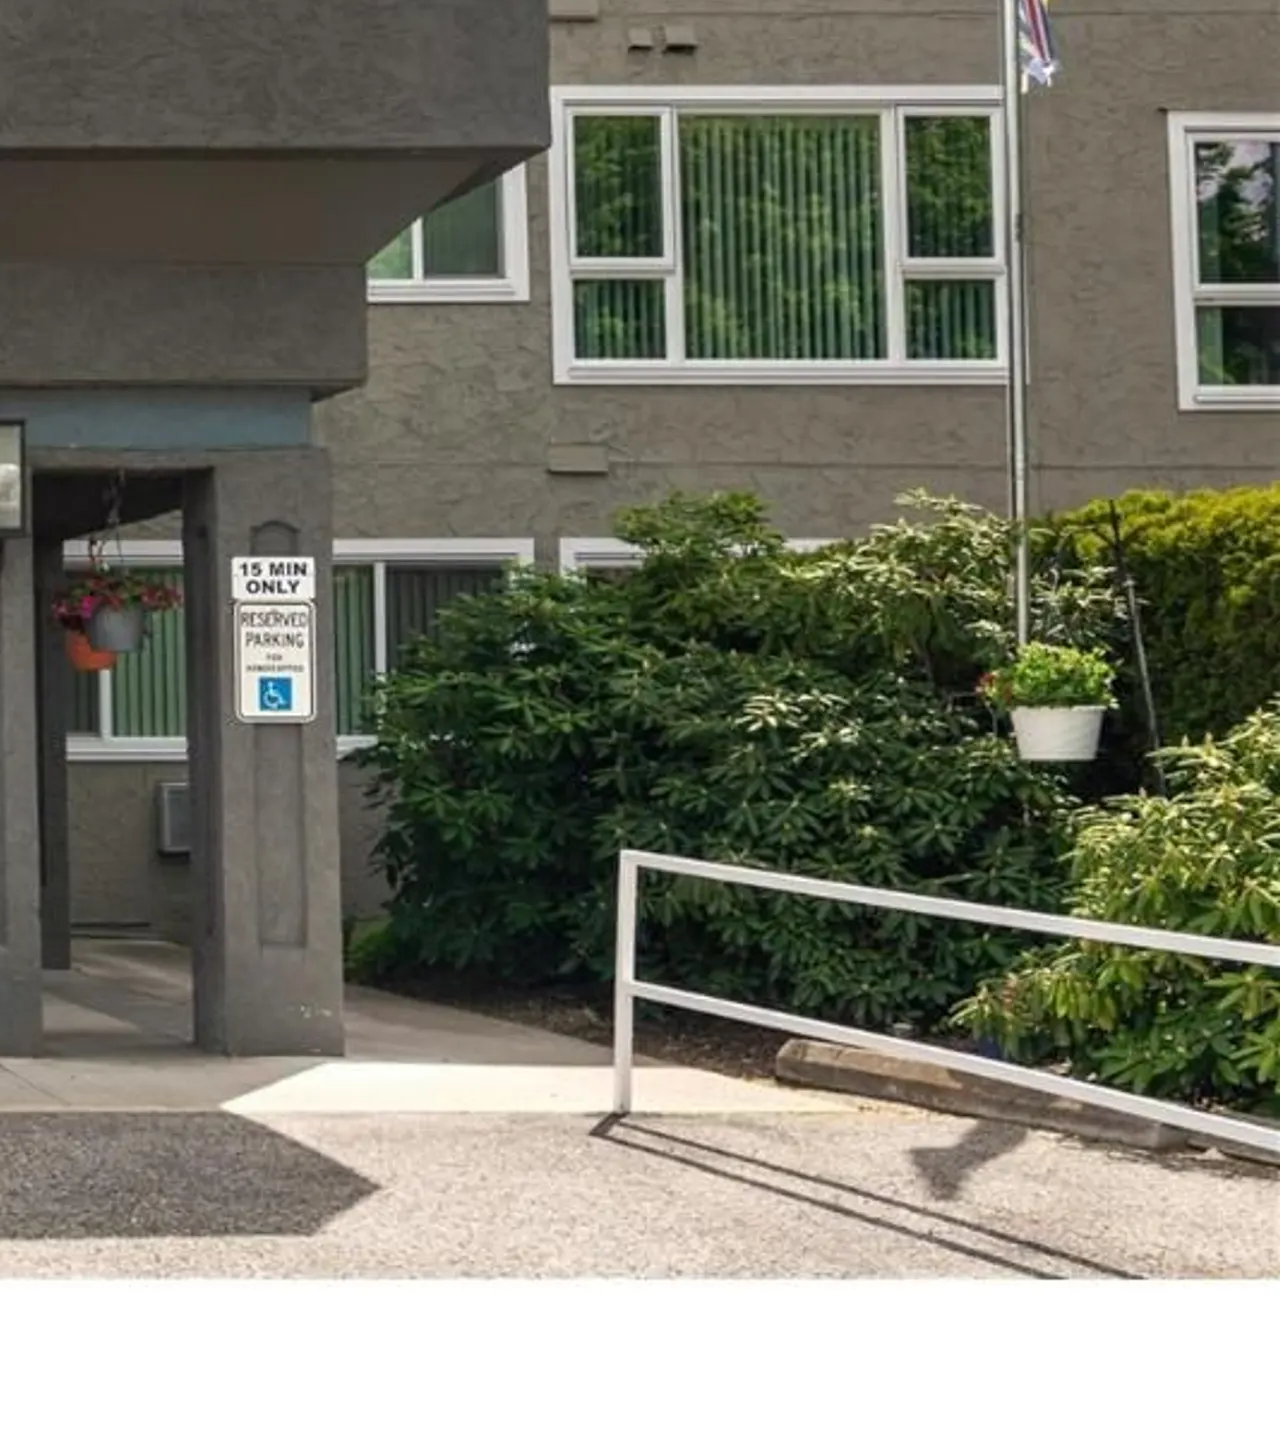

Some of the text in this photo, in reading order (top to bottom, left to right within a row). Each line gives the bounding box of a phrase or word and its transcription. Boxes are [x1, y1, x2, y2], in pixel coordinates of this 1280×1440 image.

[239, 562, 308, 577] 15 MIN
[245, 580, 300, 594] ONLY
[240, 612, 308, 628] RESERVED
[245, 631, 305, 649] PARKING
